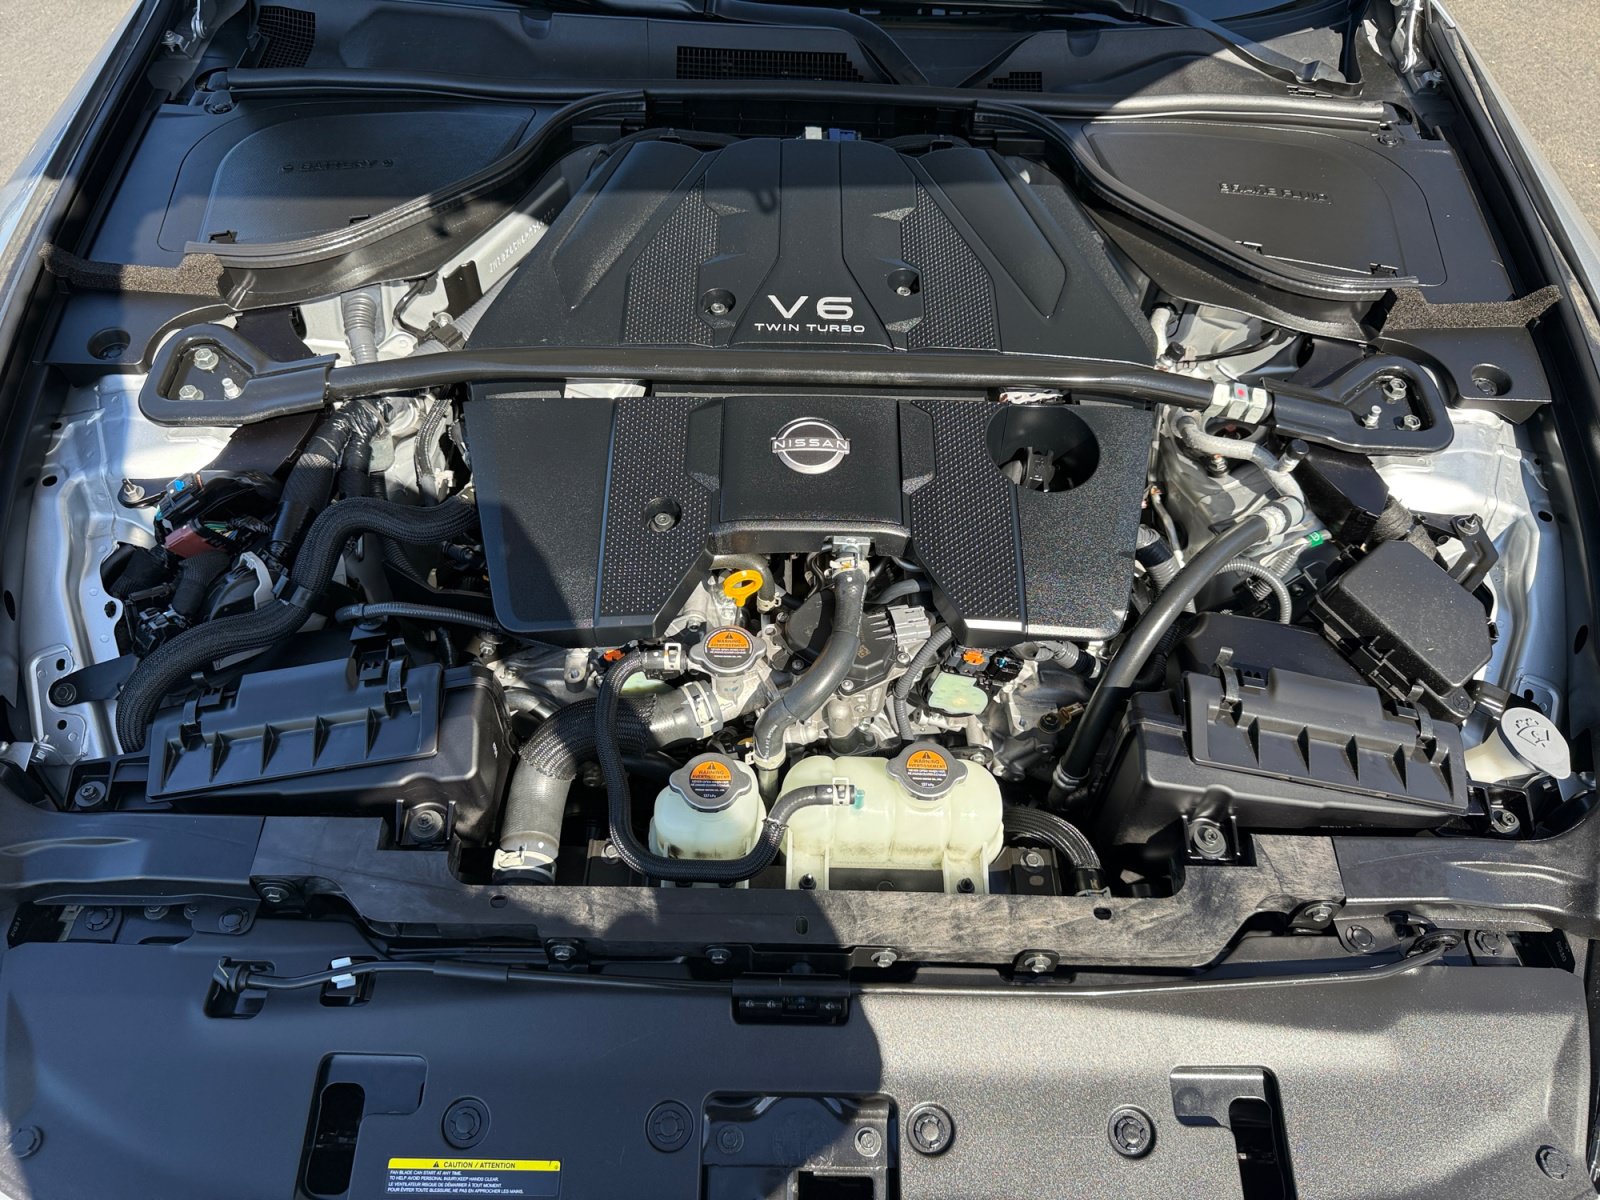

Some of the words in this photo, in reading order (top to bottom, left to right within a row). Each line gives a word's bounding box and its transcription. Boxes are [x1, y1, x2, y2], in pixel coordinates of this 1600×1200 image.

[767, 294, 854, 320] V6
[754, 323, 800, 332] TWIN
[806, 323, 865, 333] TURBO
[774, 438, 849, 450] NISSAN
